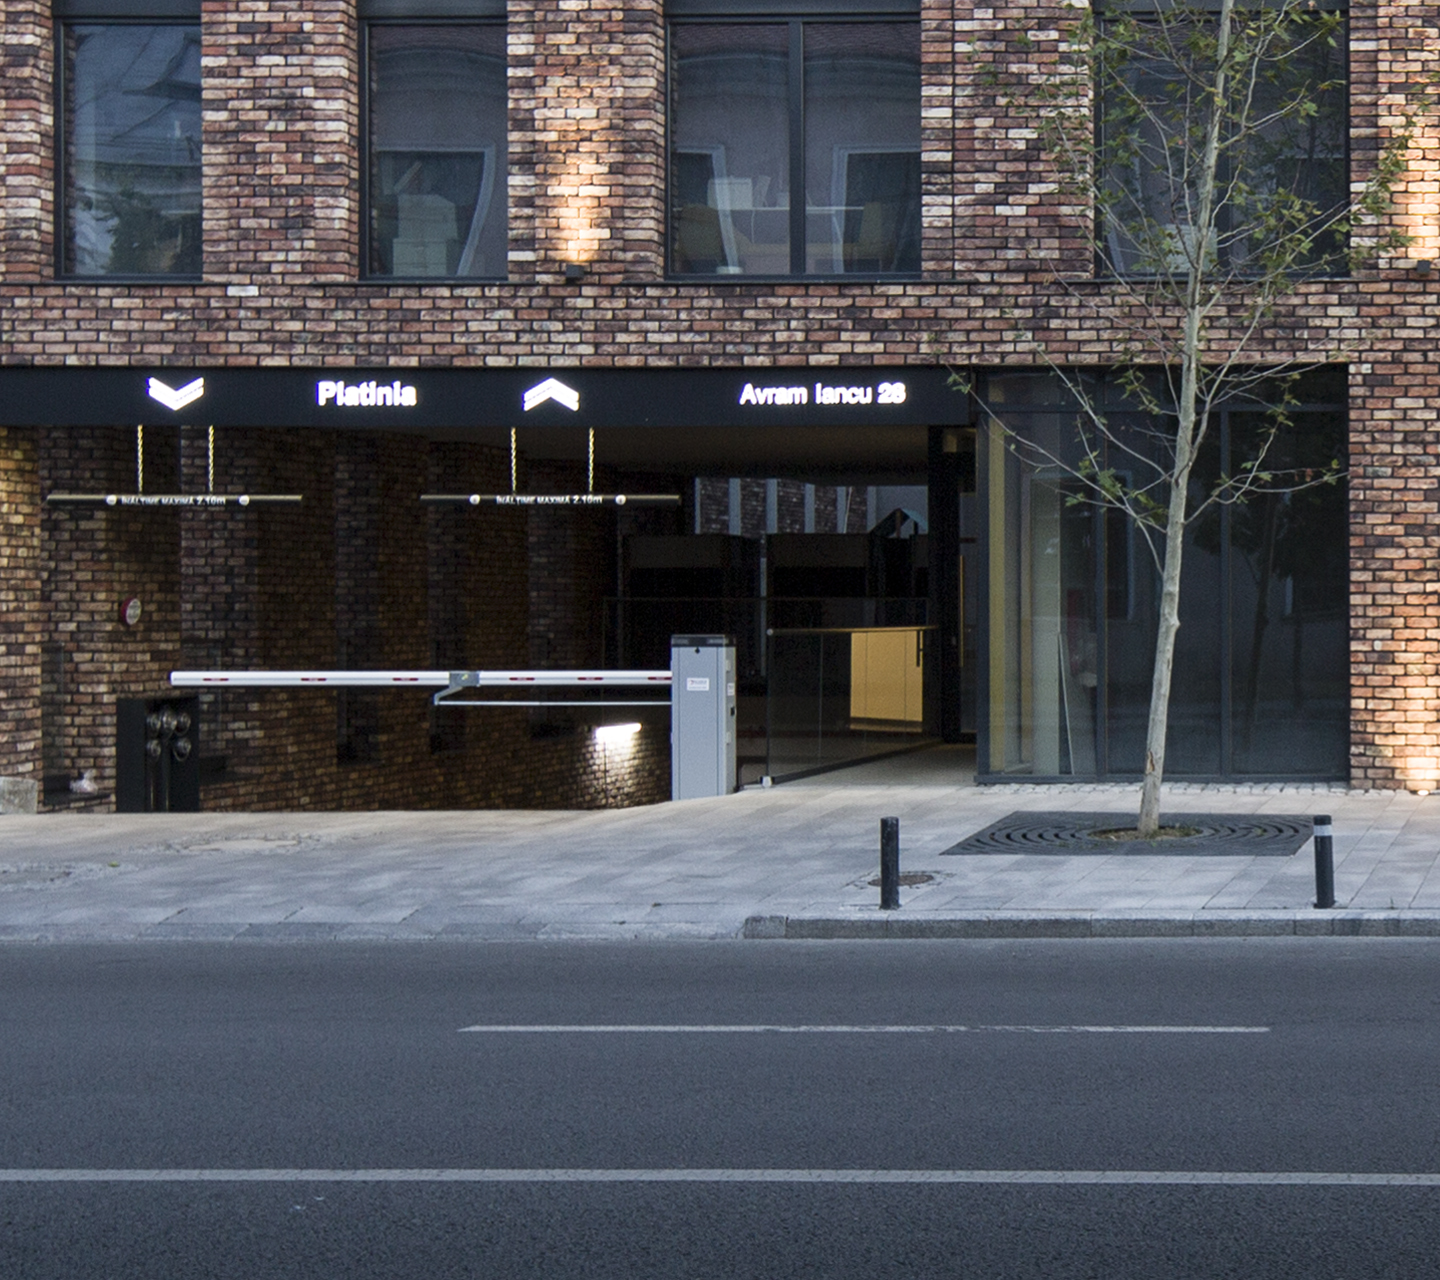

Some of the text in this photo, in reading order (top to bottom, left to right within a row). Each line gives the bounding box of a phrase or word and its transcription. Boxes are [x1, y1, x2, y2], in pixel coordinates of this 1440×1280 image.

[317, 380, 417, 406] Platinia
[739, 382, 907, 405] Avram Iancu 28
